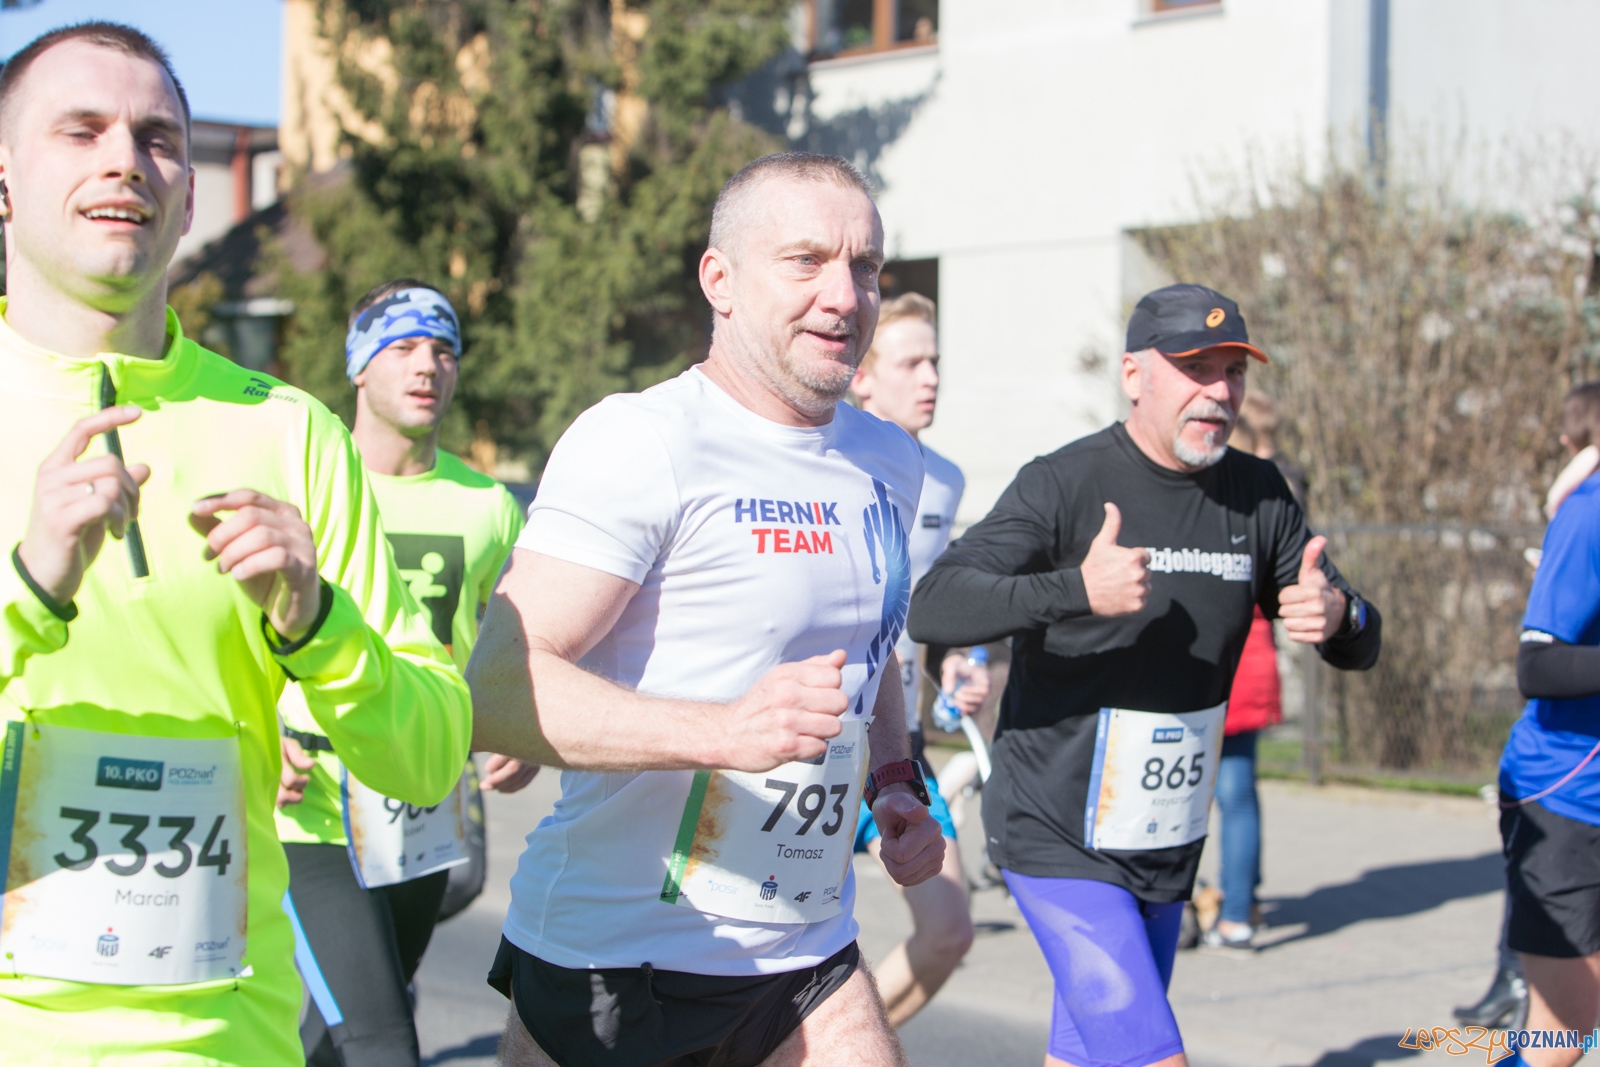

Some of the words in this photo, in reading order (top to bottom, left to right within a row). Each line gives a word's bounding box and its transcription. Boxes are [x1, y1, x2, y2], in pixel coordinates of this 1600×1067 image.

[735, 498, 841, 525] HERNIK
[751, 528, 834, 554] TEAM
[104, 765, 123, 780] 10.
[125, 767, 159, 783] PKO
[1141, 751, 1205, 791] 865
[760, 778, 849, 836] 793
[54, 806, 232, 879] 3334
[776, 844, 824, 860] Tomasz
[115, 889, 180, 906] Marcin
